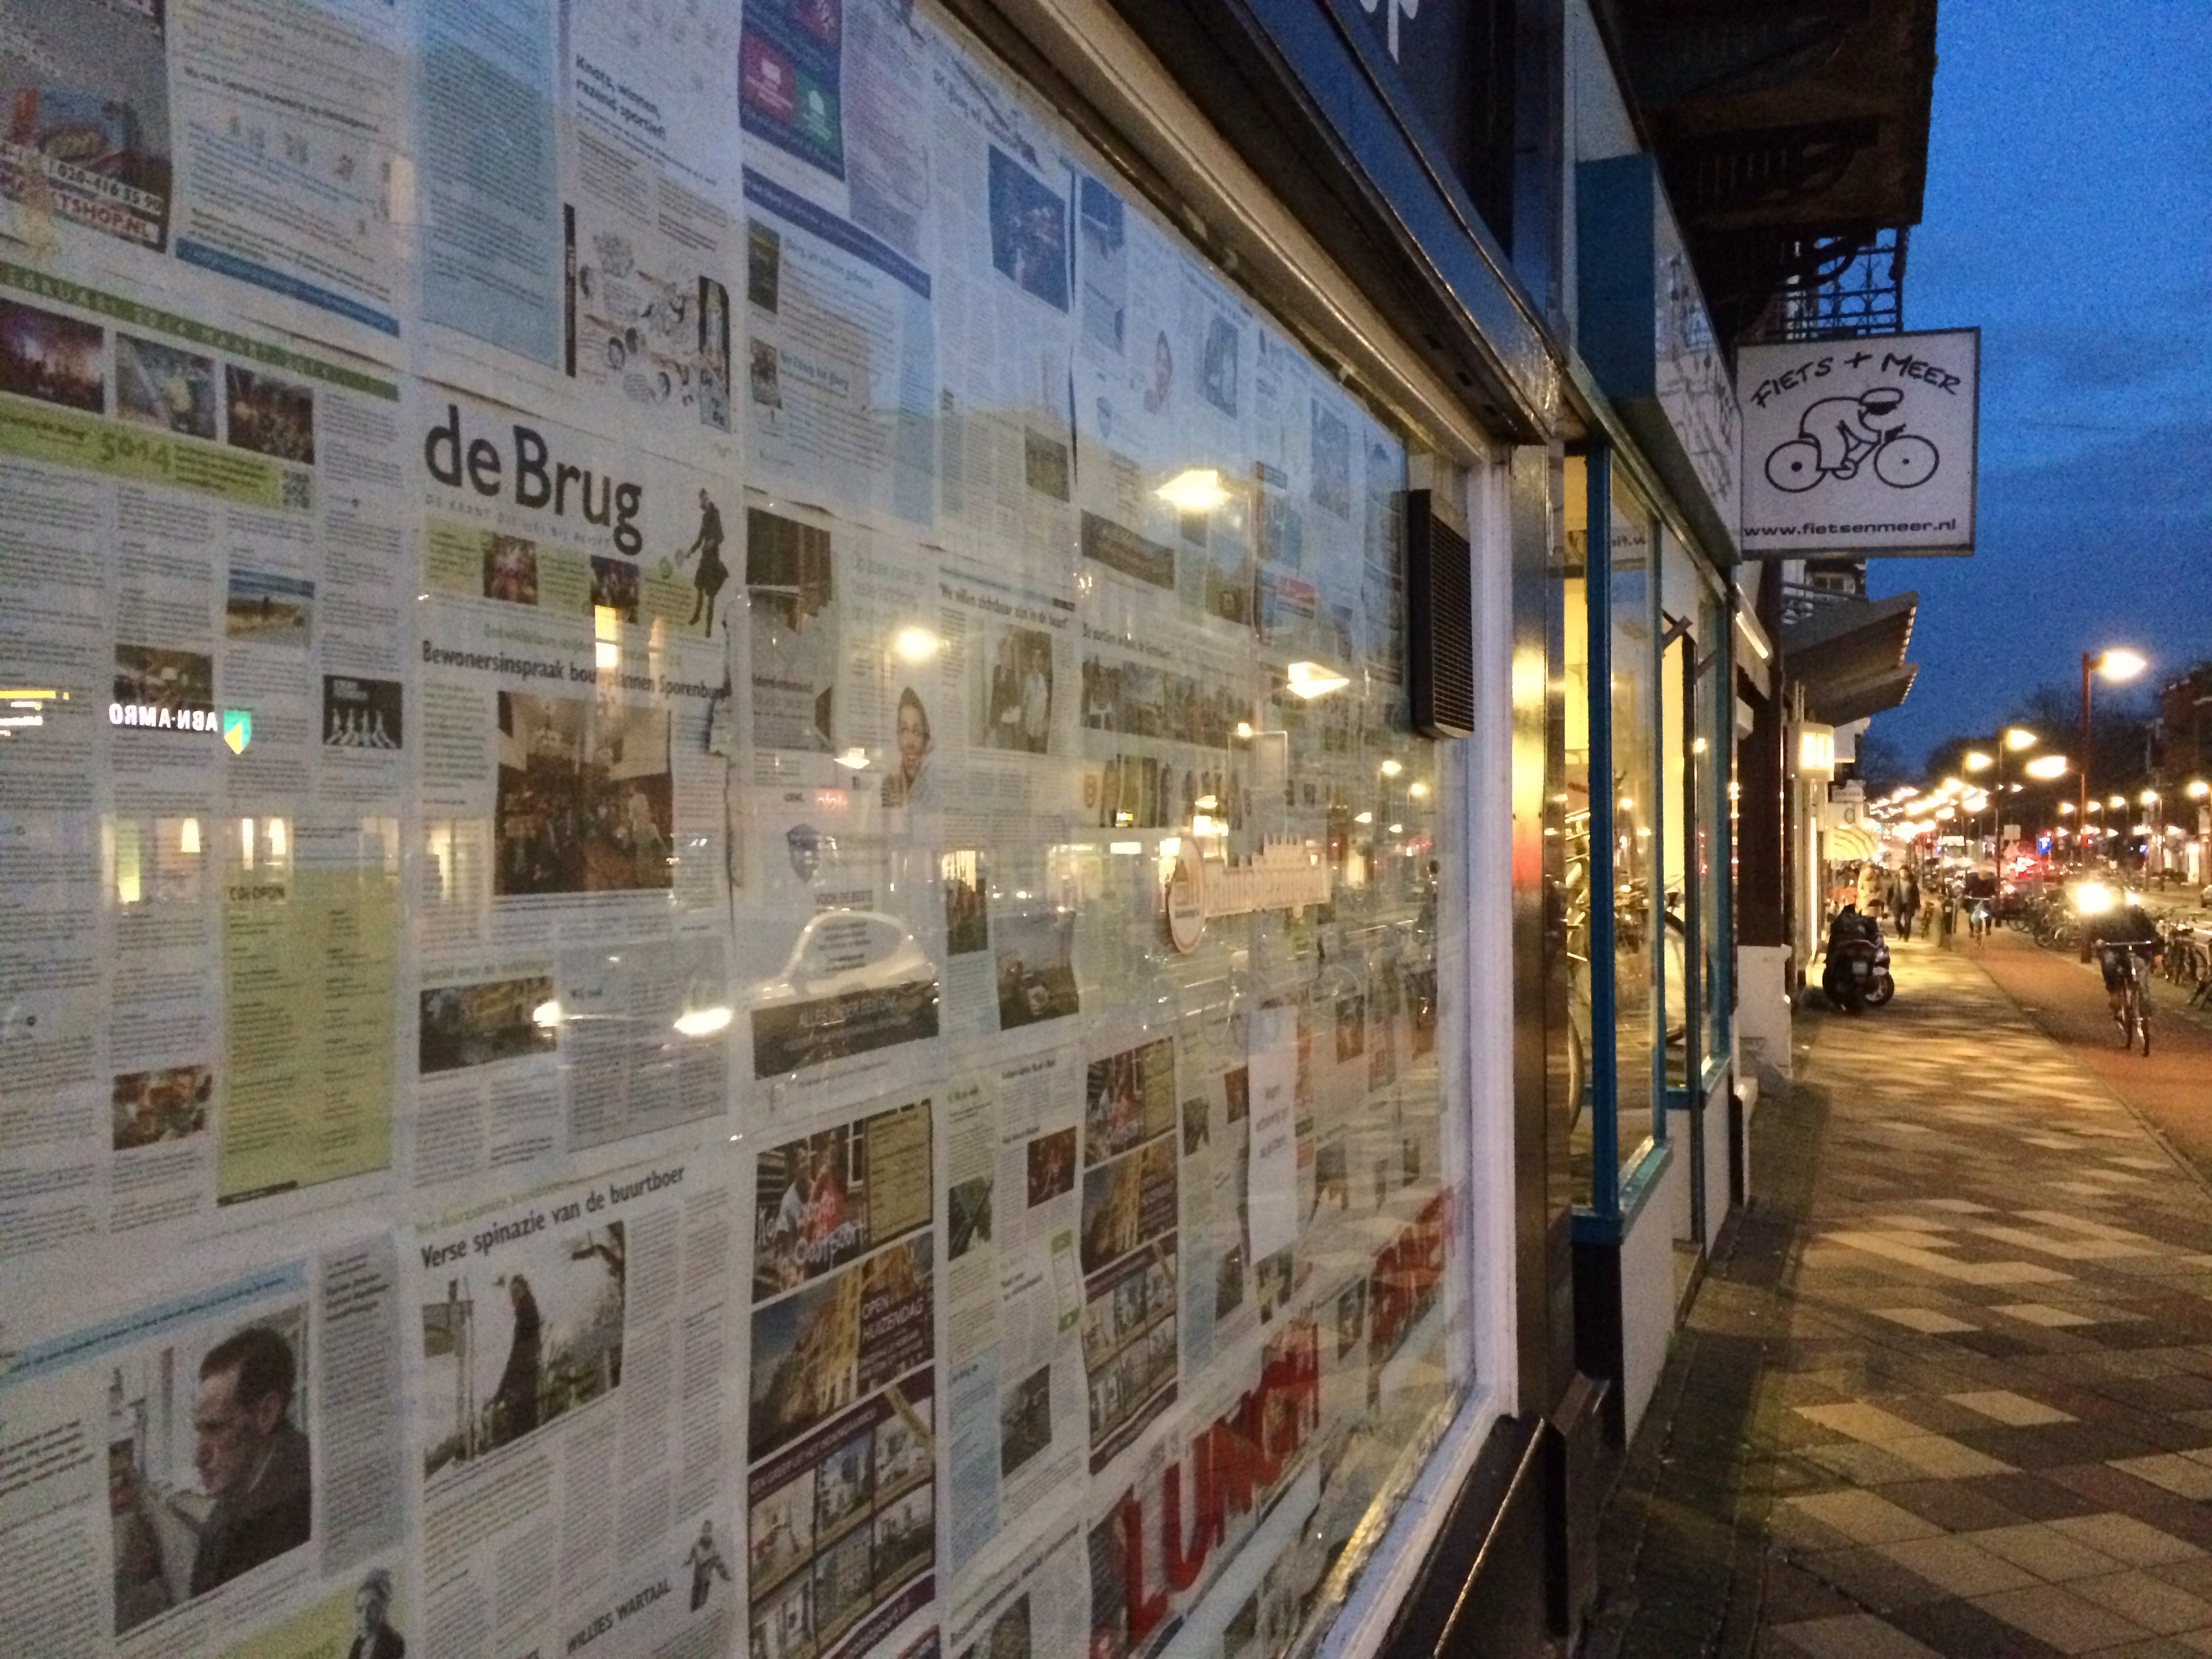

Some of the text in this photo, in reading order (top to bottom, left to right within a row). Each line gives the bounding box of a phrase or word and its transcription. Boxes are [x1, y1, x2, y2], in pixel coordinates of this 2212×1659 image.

[1750, 351, 1963, 410] FIETS + MEER
[1743, 518, 1958, 539] www.fietsenmeer.nl
[422, 640, 565, 682] Bewonersinspraak
[421, 1239, 467, 1269] Verse
[472, 1216, 546, 1256] spinazie
[551, 1203, 580, 1227] van
[584, 1191, 606, 1214] de
[608, 1164, 686, 1205] buurtboer
